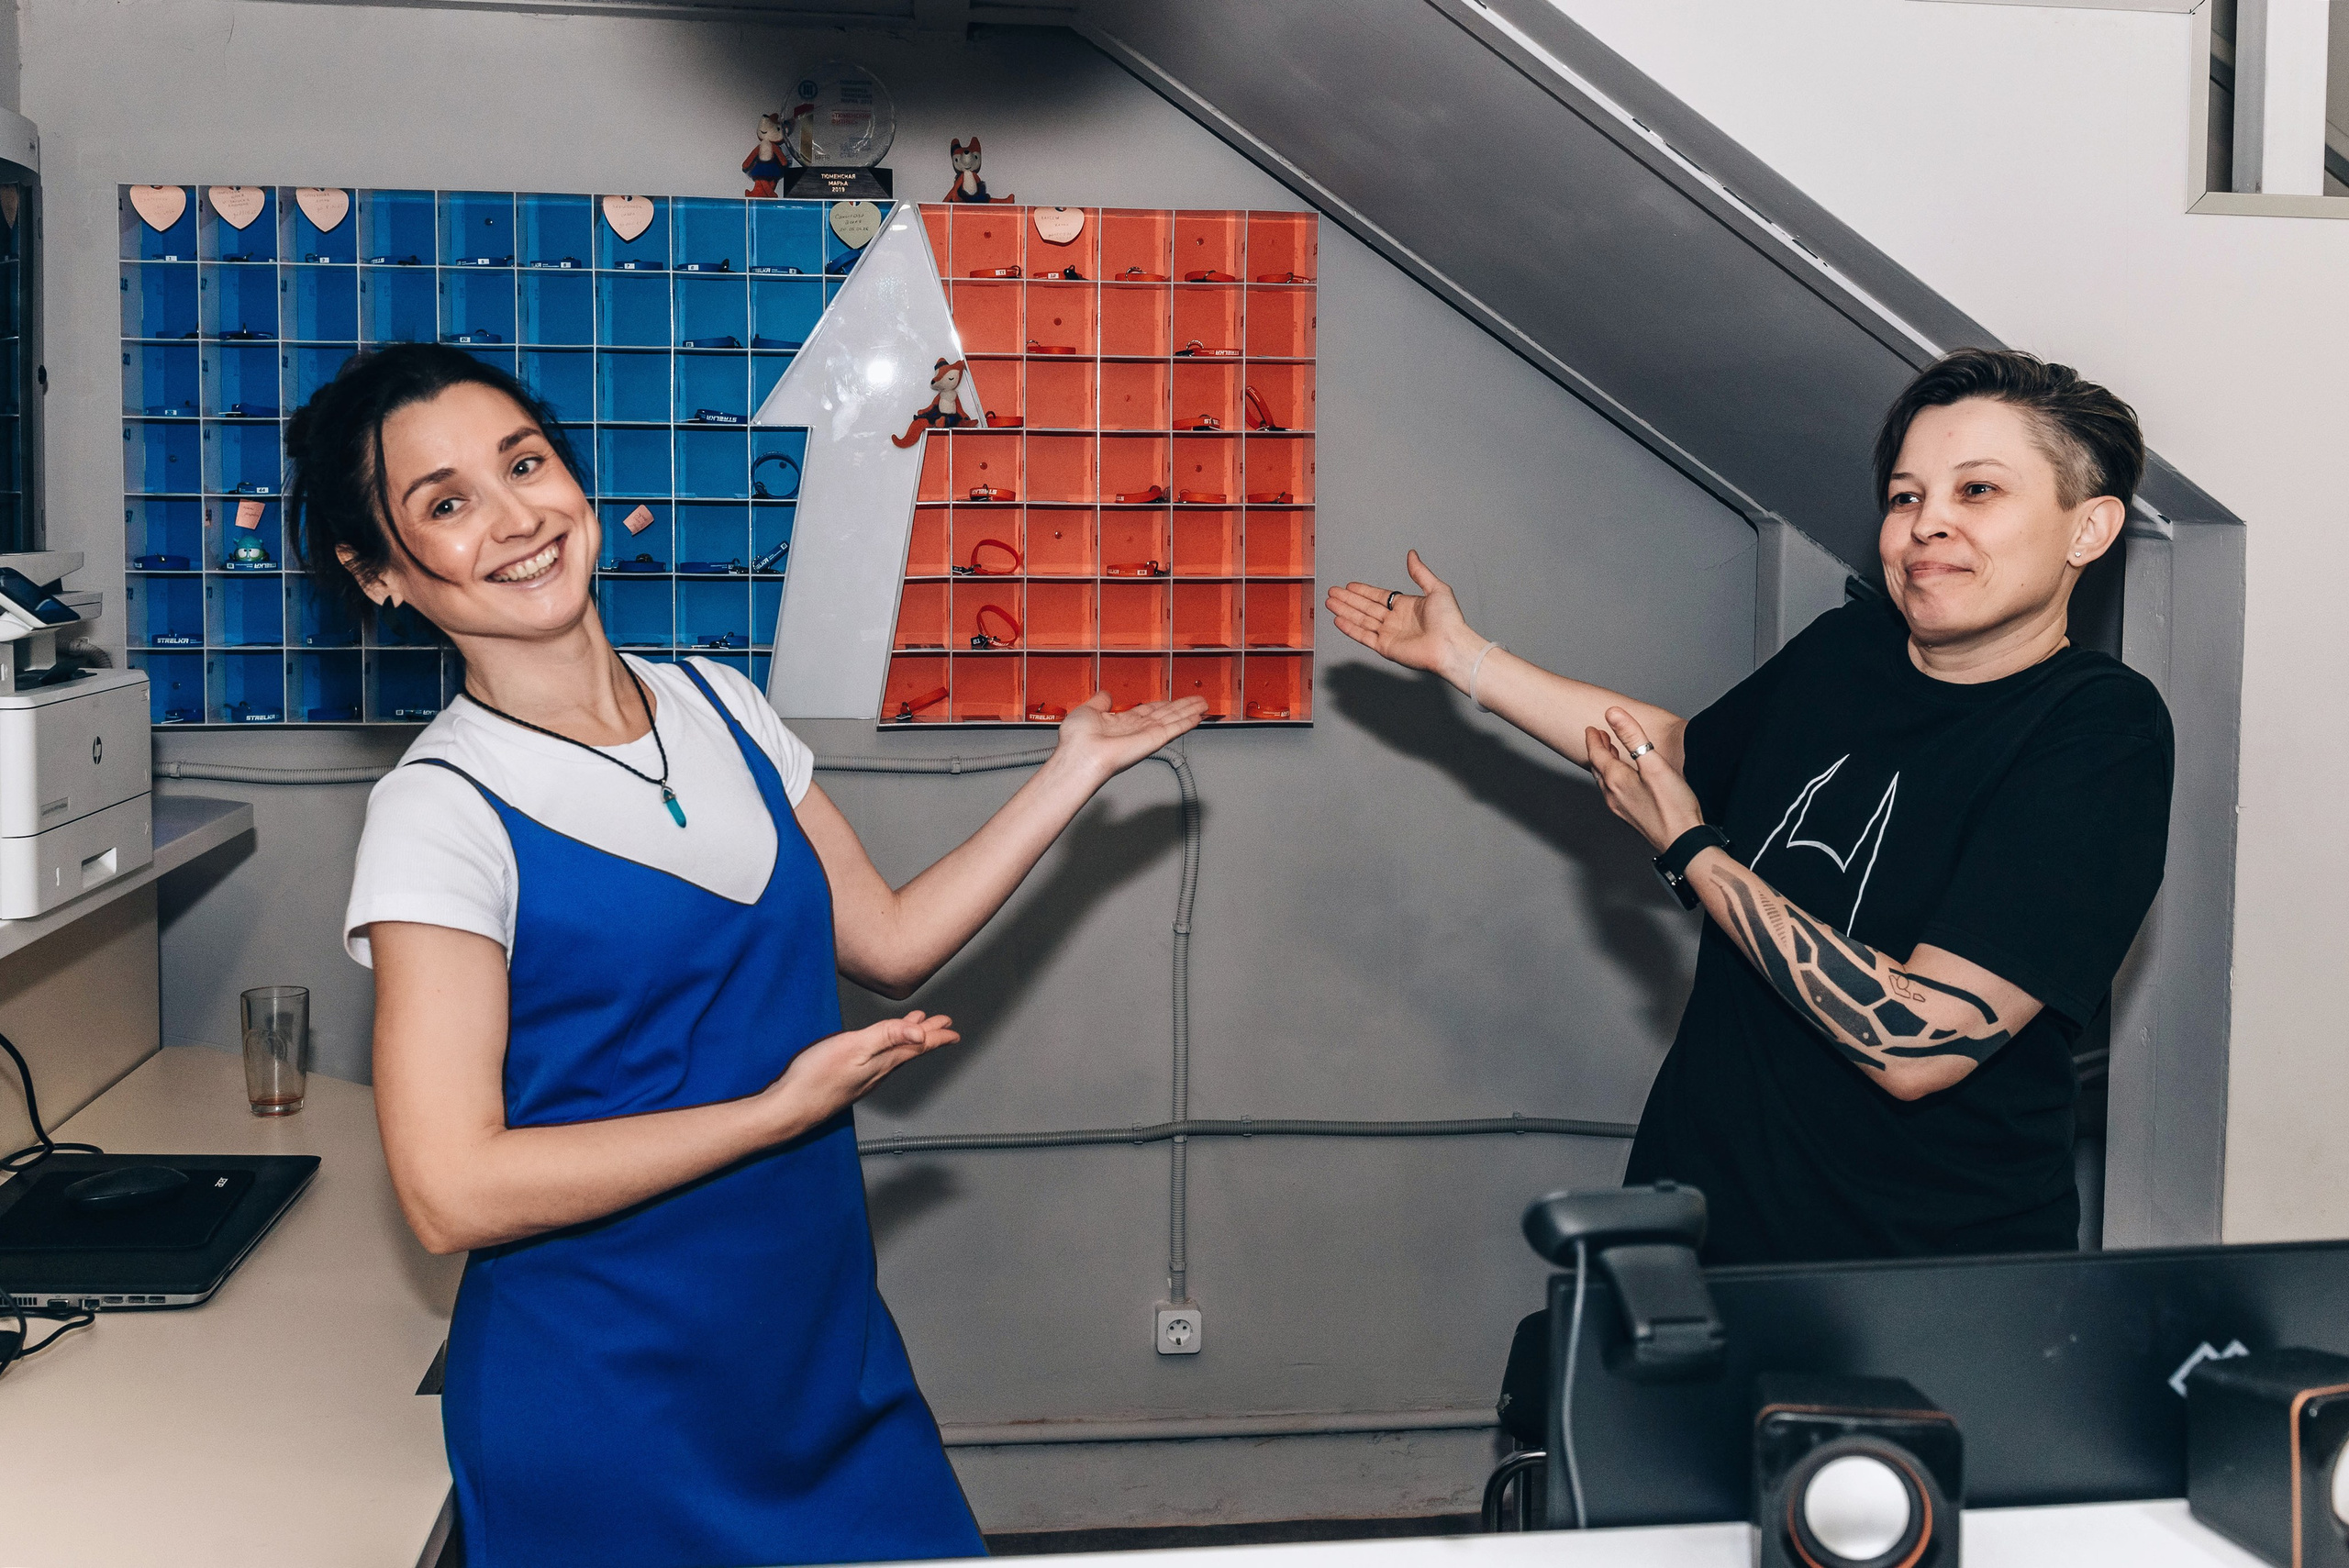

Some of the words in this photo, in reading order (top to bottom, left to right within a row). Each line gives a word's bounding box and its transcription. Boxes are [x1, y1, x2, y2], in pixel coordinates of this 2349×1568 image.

[120, 277, 128, 291] 16
[122, 352, 130, 366] 30
[122, 428, 131, 441] 43
[203, 428, 211, 441] 44
[125, 509, 133, 523] 57
[126, 586, 134, 600] 72
[206, 586, 213, 599] 73
